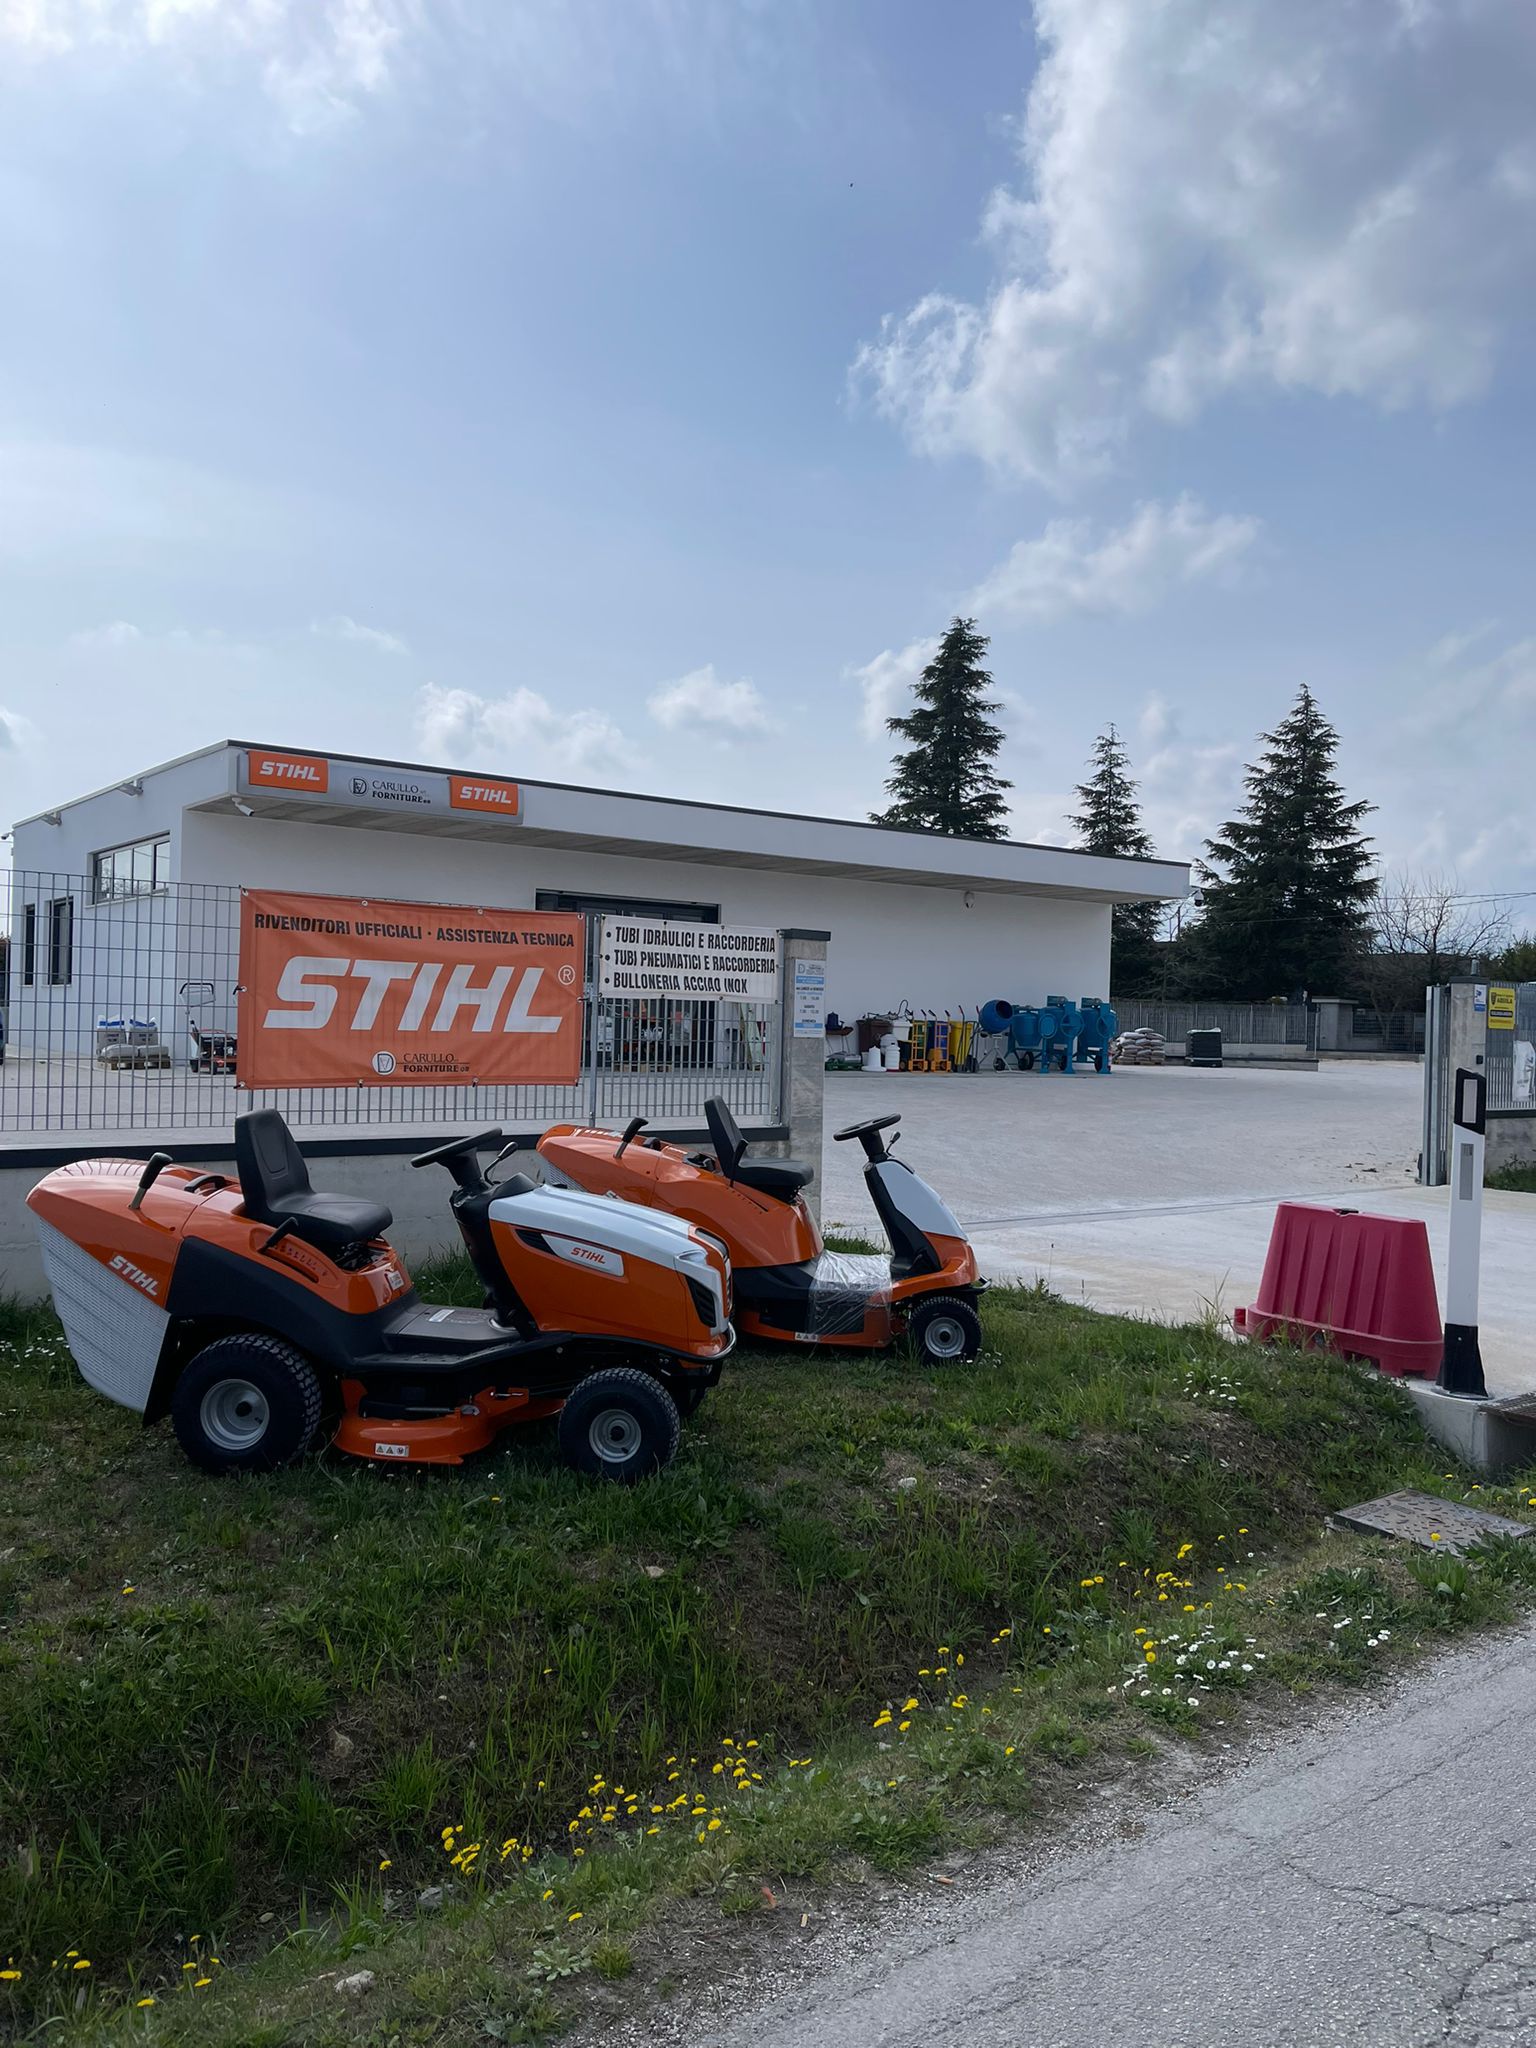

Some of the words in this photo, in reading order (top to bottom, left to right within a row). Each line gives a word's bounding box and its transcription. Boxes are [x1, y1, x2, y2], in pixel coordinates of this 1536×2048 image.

[259, 761, 320, 781] STIHL
[372, 780, 419, 794] CARULLO
[372, 791, 423, 803] FORNITURE
[460, 785, 512, 804] STIHL
[254, 913, 350, 935] RIVENDITORI
[355, 922, 422, 940] UFFICIALI
[436, 927, 519, 944] ASSISTENZA
[521, 932, 574, 947] TECNICA
[615, 926, 640, 944] TUBI
[643, 928, 695, 948] IDRAULICI
[698, 933, 704, 948] E
[708, 933, 775, 953] RACCORDERIA
[614, 949, 637, 966] TUBI
[640, 951, 701, 970] PNEUMATICI
[704, 955, 710, 970] E
[712, 956, 775, 974] RACCORDERIA
[613, 972, 680, 990] BULLONERIA
[683, 976, 721, 992] ACCIAO
[723, 978, 748, 994] INOX
[263, 956, 562, 1033] STIHL
[403, 1053, 455, 1063] CARULLO
[403, 1064, 459, 1073] FORNITURE
[571, 1247, 606, 1264] STIHL
[109, 1255, 159, 1296] STIHL
